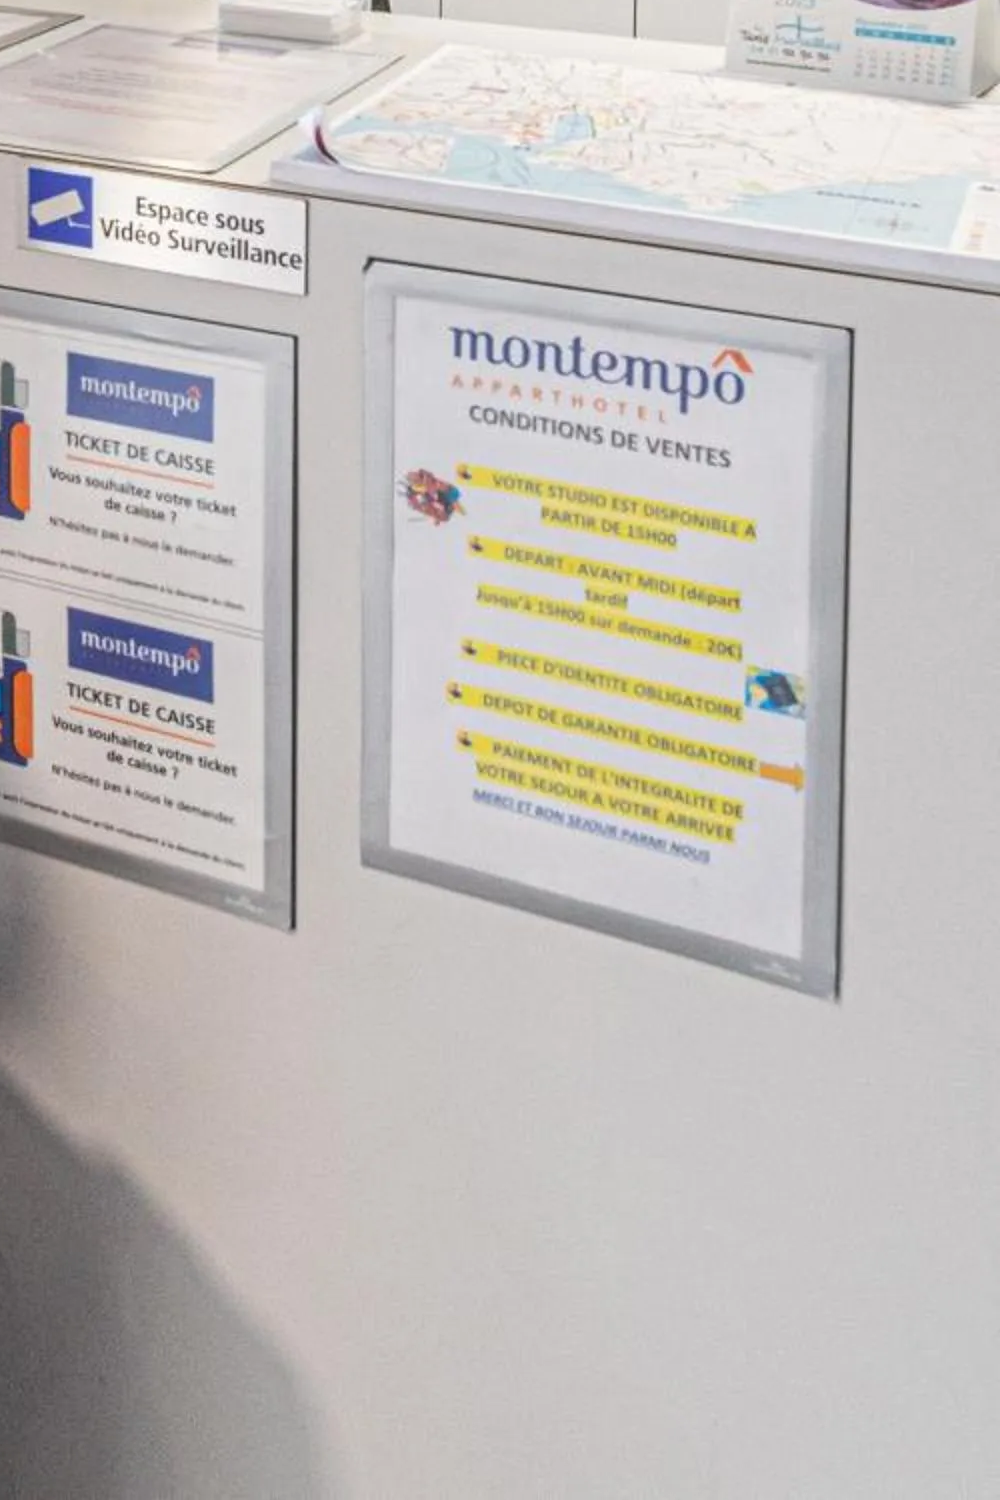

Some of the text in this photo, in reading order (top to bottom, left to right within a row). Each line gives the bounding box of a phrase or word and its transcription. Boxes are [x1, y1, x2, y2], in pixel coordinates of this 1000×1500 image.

[135, 196, 265, 235] Espace sous
[100, 217, 303, 270] Vidéo Surveillance
[80, 375, 202, 417] montempô
[449, 326, 754, 415] montempô
[451, 373, 668, 424] APPARTHOTEL
[64, 430, 216, 476] TICKET DE CAISSE
[469, 404, 732, 468] CONDITIONS DE VENTES
[48, 465, 237, 517] Vous souhaitez votre ticket
[104, 497, 177, 525] de caisse ?
[491, 473, 545, 496] VOTRE
[548, 485, 607, 508] STUDIO
[611, 498, 639, 514] EST
[643, 503, 738, 536] DISPONIBLE
[101, 529, 120, 542] pas
[161, 539, 172, 551] le
[541, 506, 677, 547] PARTIR DE 15H00
[504, 547, 564, 570] DEPART
[577, 563, 633, 584] AVANT
[637, 574, 676, 594] MIDI
[538, 601, 585, 622] 15H00
[589, 615, 612, 629] sur
[618, 620, 692, 647] demande
[585, 589, 628, 609] tardif
[80, 629, 202, 677] montempô
[67, 681, 216, 735] TICKET DE CAISSE
[498, 649, 743, 721] PIECE D'IDENTITE OBLIGATOIRE
[51, 714, 238, 777] Vous souhaitez votre ticket
[483, 693, 758, 773] DEPOT DE GARANTIE OBLIGATOIRE
[107, 750, 180, 780] de caisse ?
[493, 742, 744, 819] PAIEMENT DE L'INTEGRALITE DE
[103, 780, 122, 793] pas
[134, 789, 160, 805] nous
[163, 795, 174, 808] le
[475, 760, 525, 785] VOTRE
[530, 775, 588, 801] SEJOUR
[608, 794, 659, 821] VOTRE
[666, 811, 734, 842] ARRIVEE
[473, 788, 710, 864] MERCI ET BON SEJOUR PARMI NOUS
